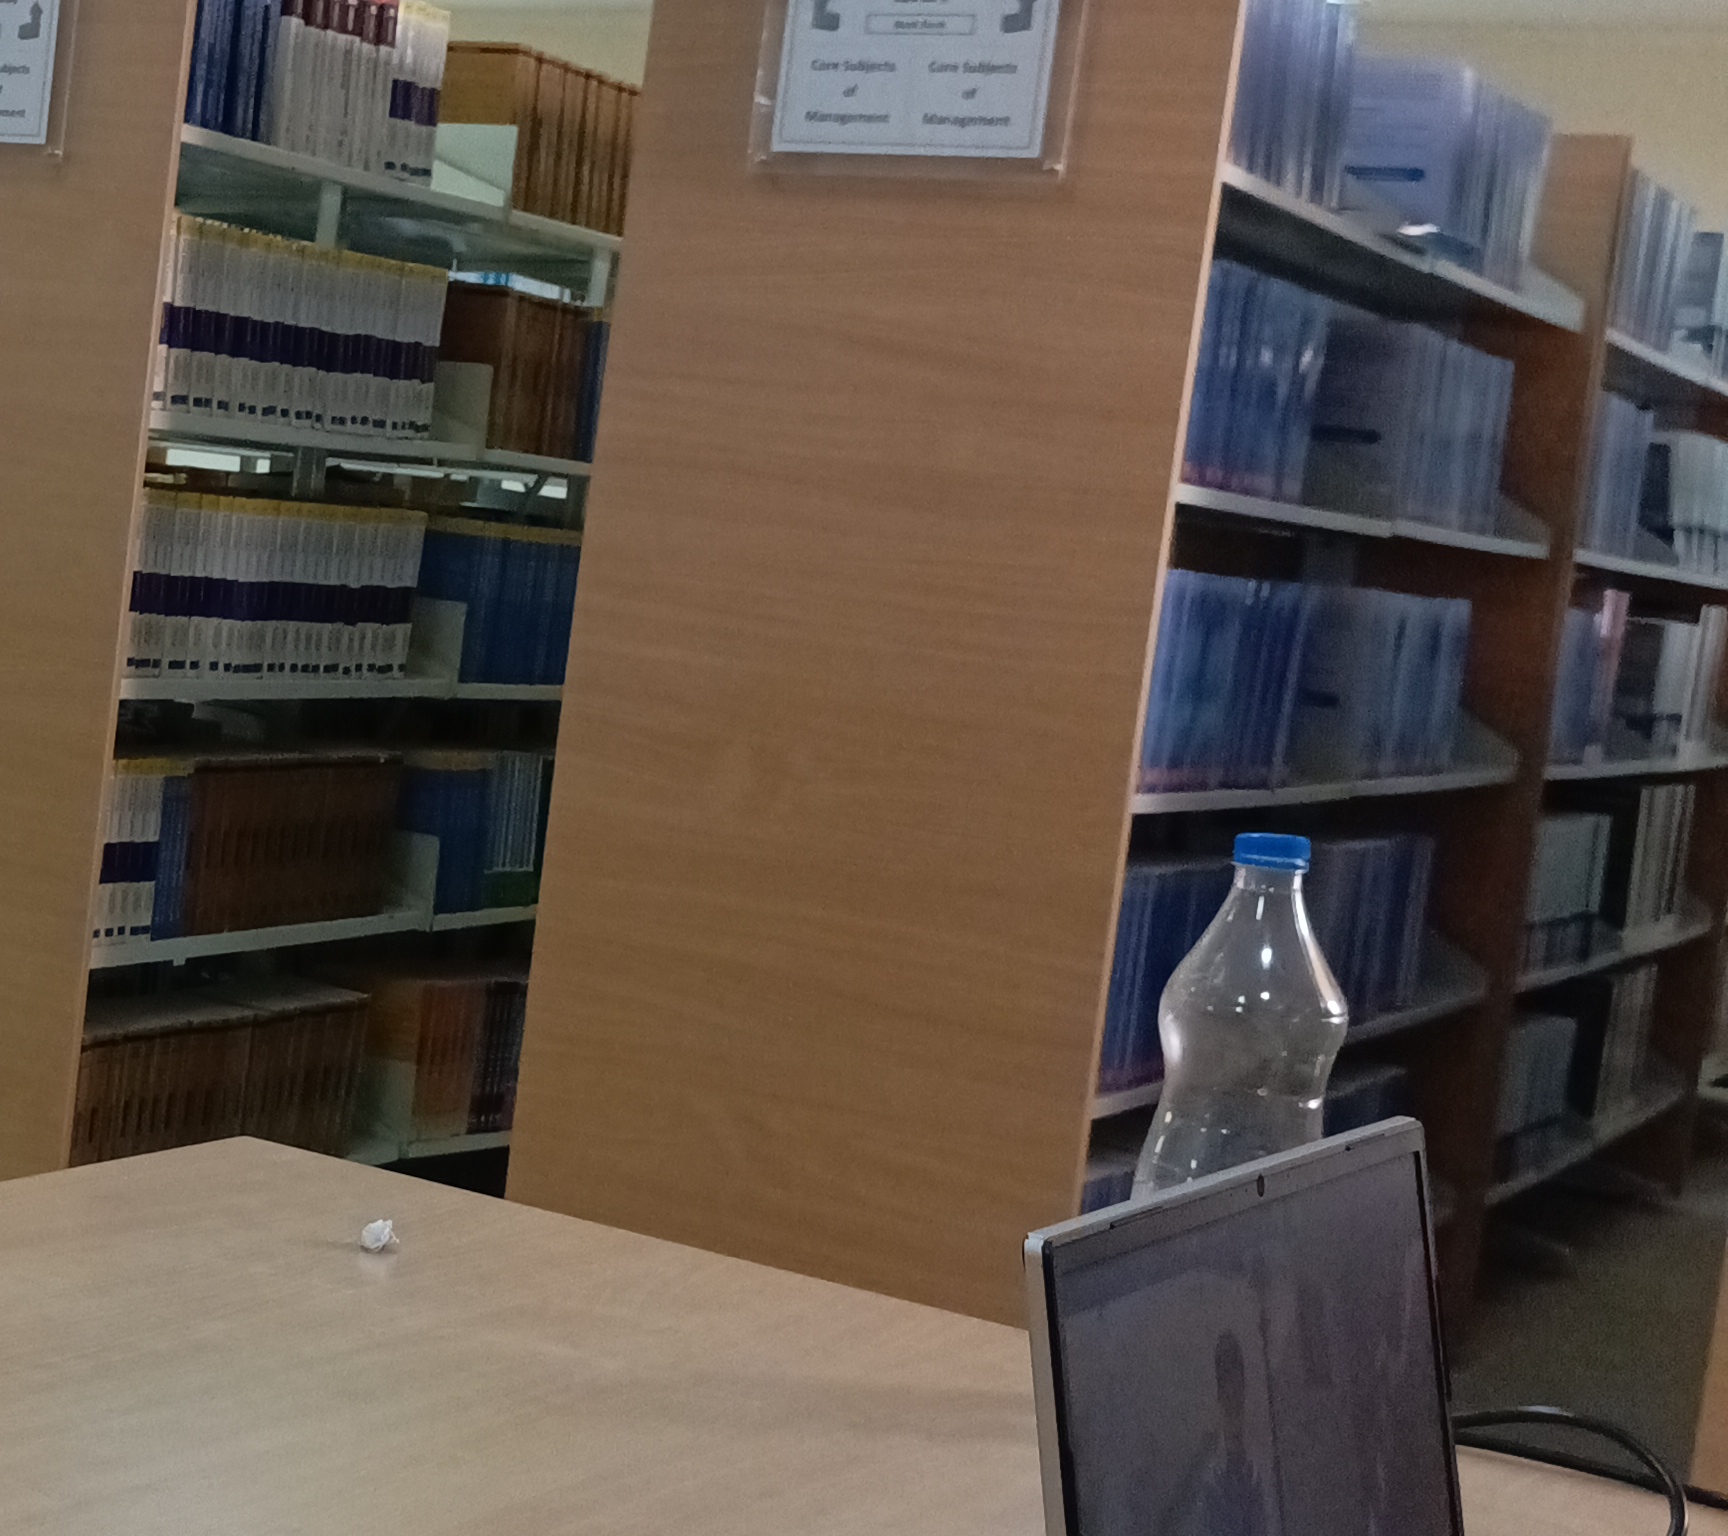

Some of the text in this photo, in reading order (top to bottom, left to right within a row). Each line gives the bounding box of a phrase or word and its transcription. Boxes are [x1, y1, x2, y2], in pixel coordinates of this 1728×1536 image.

[809, 58, 897, 74] Core Subjects
[927, 60, 1019, 76] Core Subjects
[841, 82, 860, 99] of
[960, 86, 980, 101] of
[803, 110, 891, 127] Management
[922, 112, 1012, 129] Management
